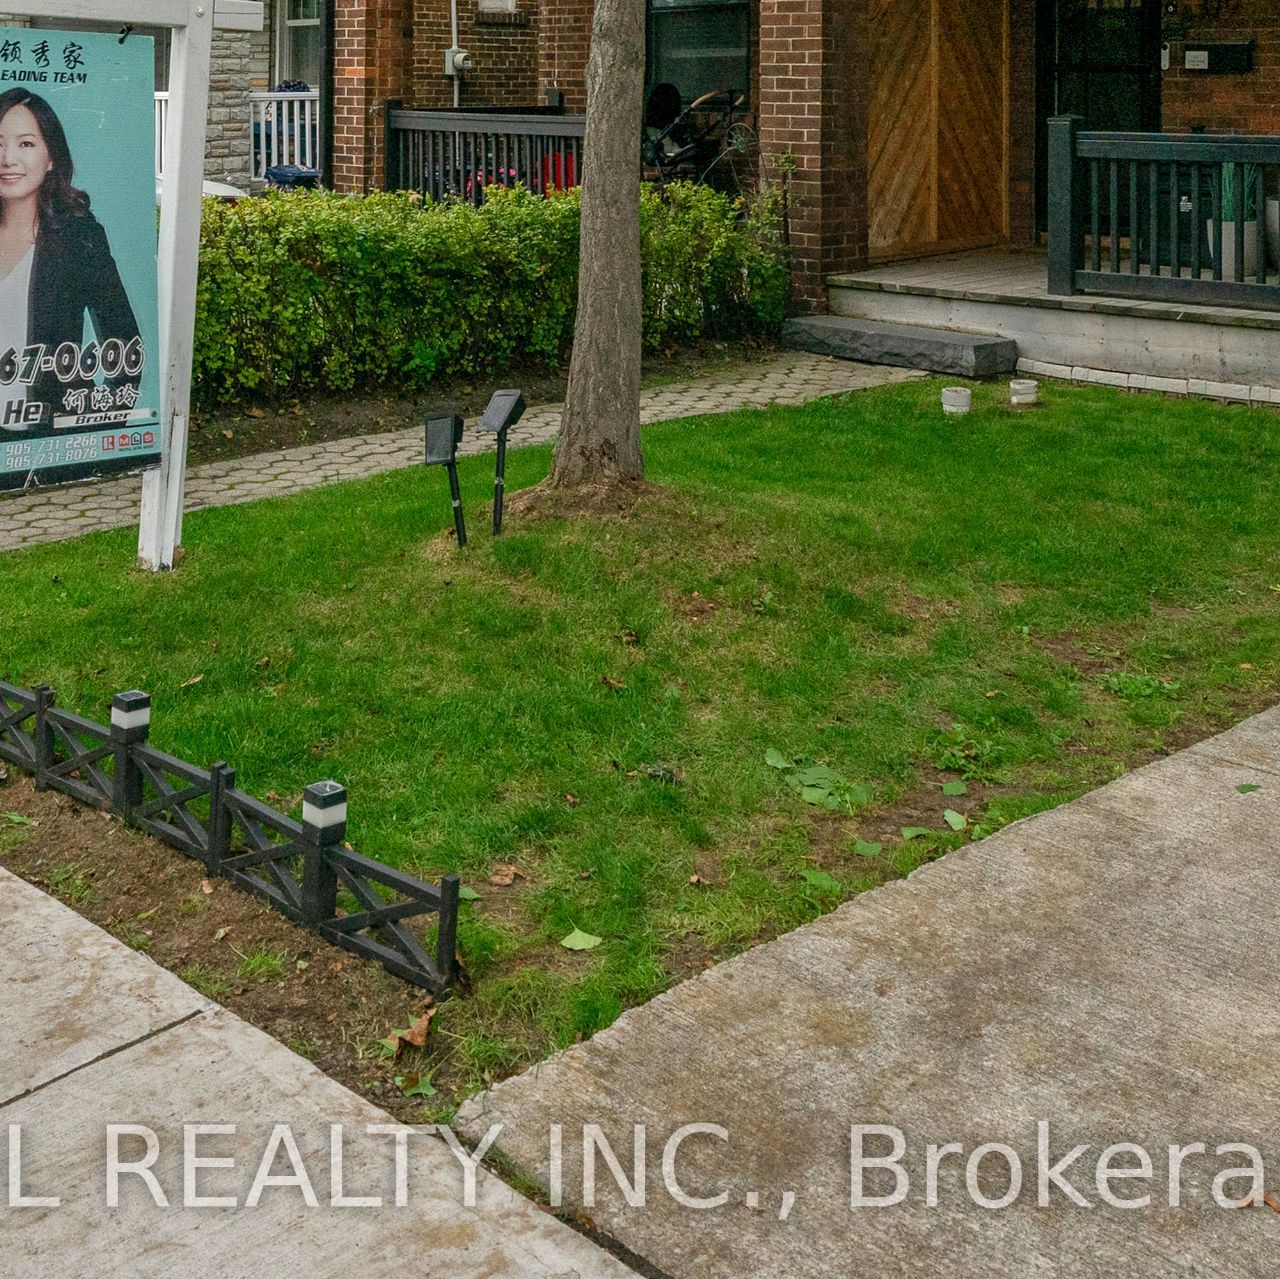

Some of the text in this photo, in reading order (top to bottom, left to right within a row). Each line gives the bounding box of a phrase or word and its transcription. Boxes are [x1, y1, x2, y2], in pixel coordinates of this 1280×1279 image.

[53, 71, 88, 84] TEAM
[62, 383, 141, 414] 何海玲
[2, 398, 44, 426] He
[75, 411, 132, 425] Broker
[5, 434, 98, 457] 905-731-2266
[5, 448, 98, 470] 905-731-8076
